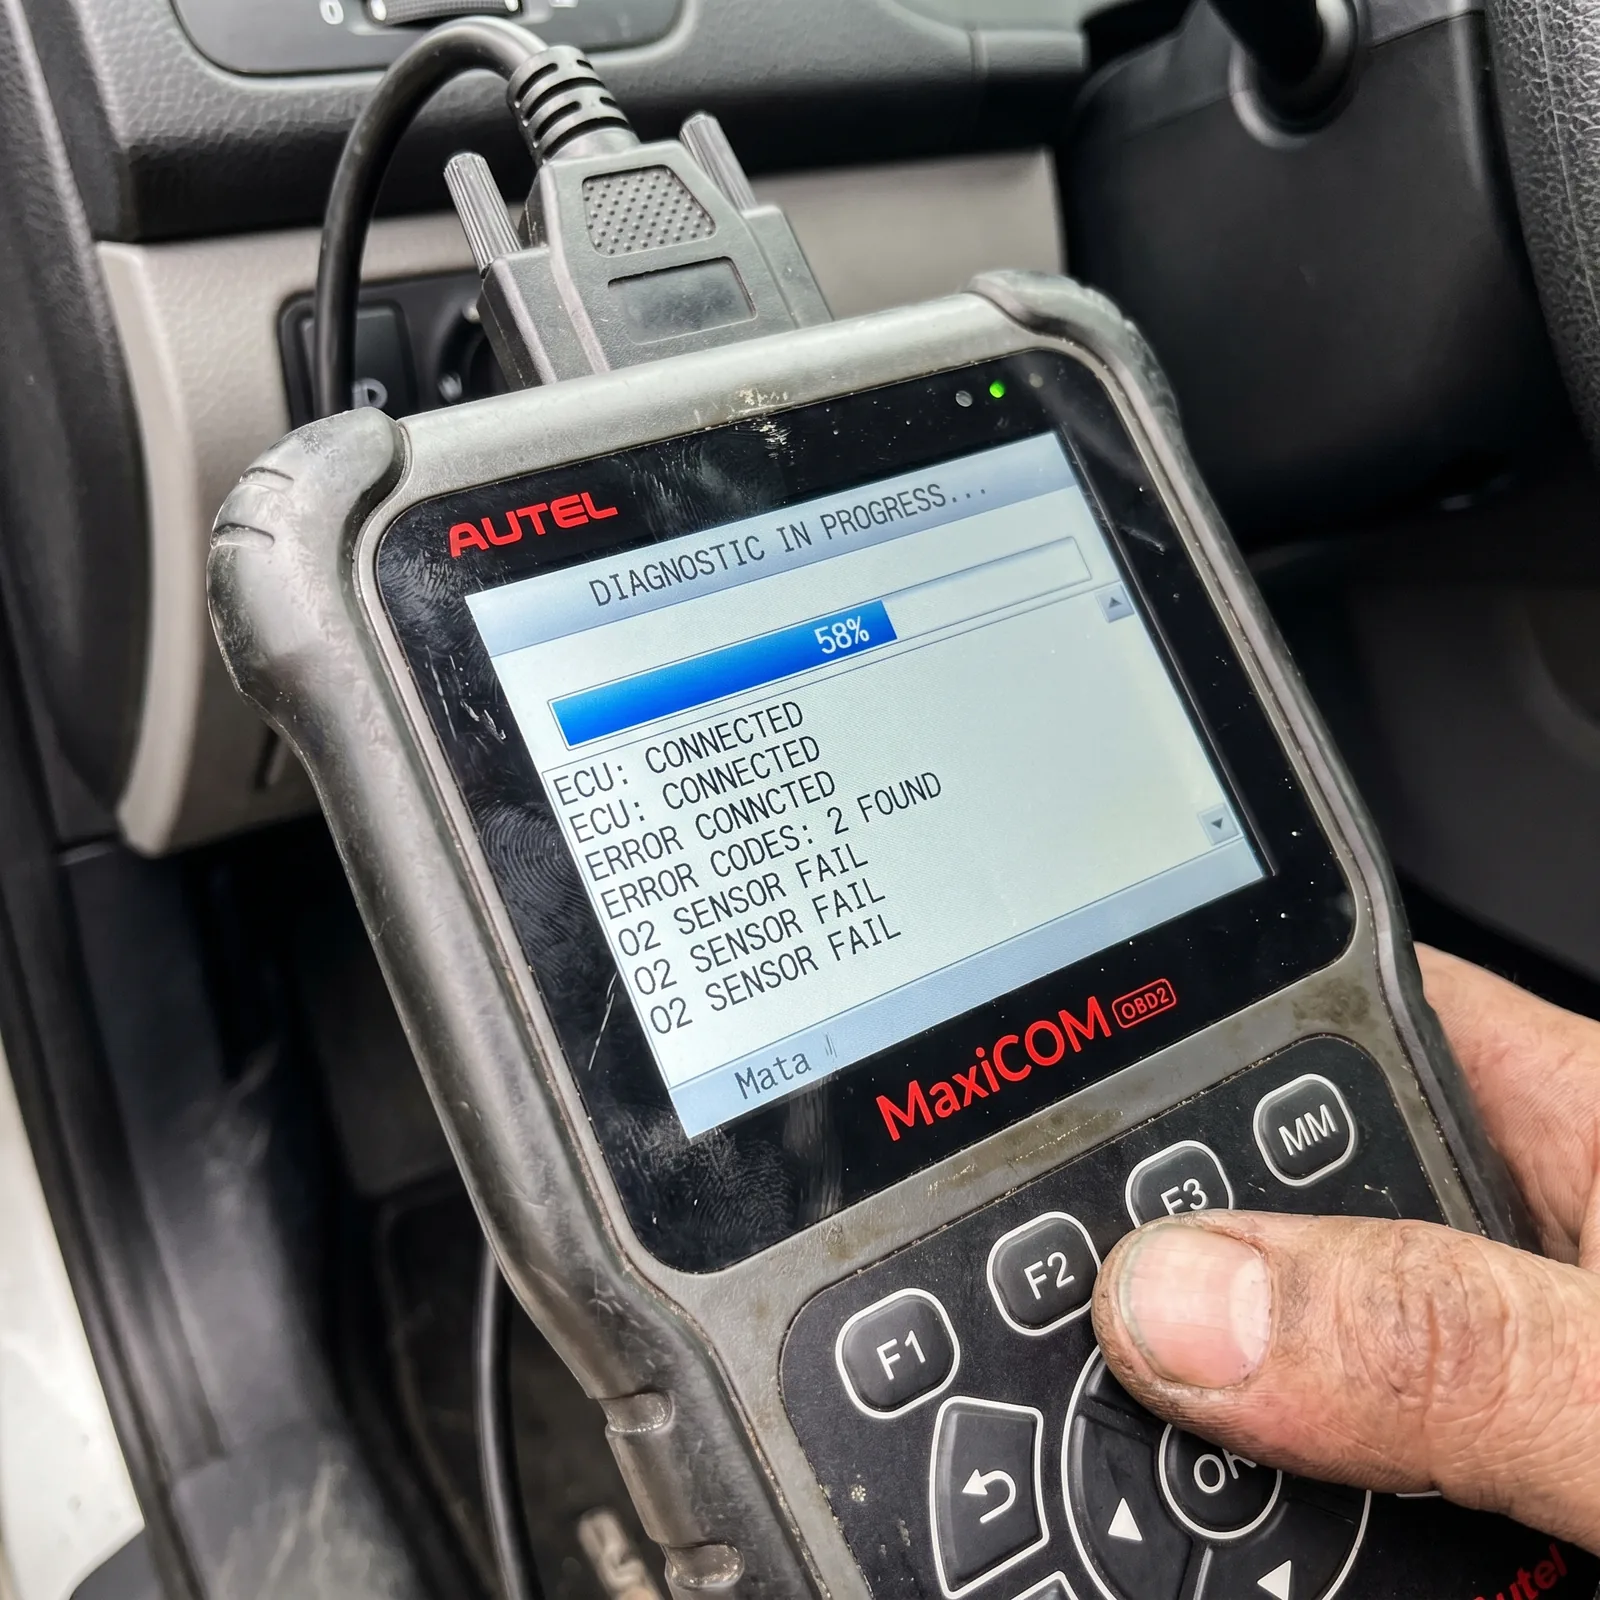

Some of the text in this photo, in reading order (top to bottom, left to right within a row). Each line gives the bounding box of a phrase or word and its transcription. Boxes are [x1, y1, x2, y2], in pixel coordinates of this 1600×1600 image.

[449, 491, 619, 558] AUTEL
[588, 483, 987, 607] DIAGNOSTIC IN PROGRESS...
[814, 615, 870, 655] 58%
[553, 701, 804, 806] ECU: CONNECTED
[569, 735, 820, 843] ECU: CONNECTED
[585, 770, 836, 881] ERROR CONNCTED
[600, 771, 942, 920] ERROR CODES: 2 FOUND
[673, 872, 787, 935] SENSOR
[795, 842, 869, 889] FAIL
[690, 908, 804, 973] SENSOR
[812, 877, 886, 924] FAIL
[705, 945, 819, 1012] SENSOR
[828, 914, 902, 962] FAIL
[734, 1049, 812, 1100] Mata
[876, 987, 1169, 1142] MaxiCOM OBD2
[1279, 1104, 1336, 1156] MM
[1023, 1251, 1075, 1300] F2
[876, 1330, 926, 1381] F1
[1474, 1543, 1568, 1600] tel
